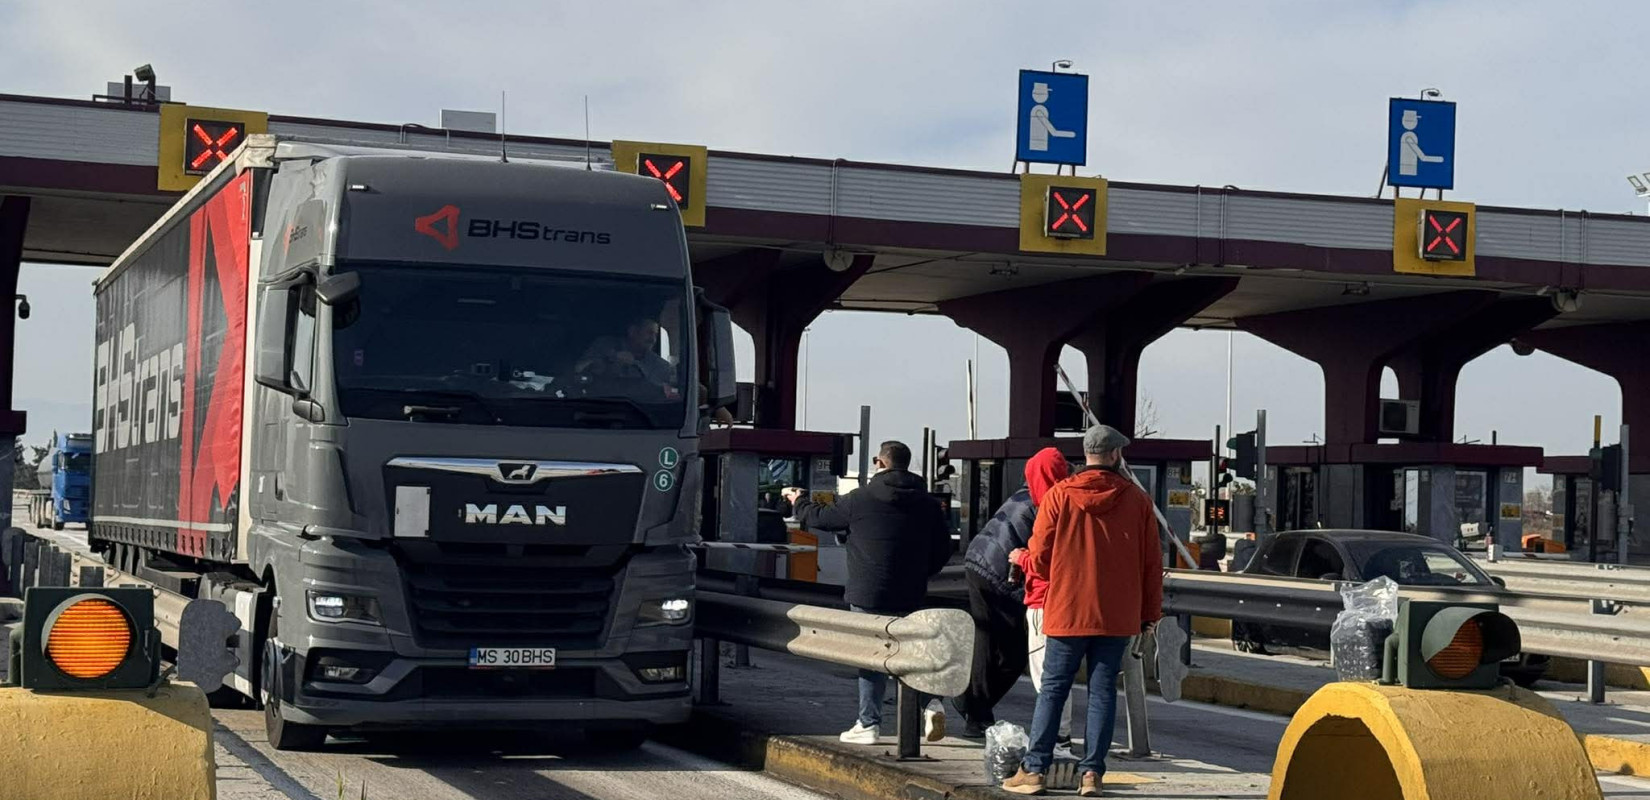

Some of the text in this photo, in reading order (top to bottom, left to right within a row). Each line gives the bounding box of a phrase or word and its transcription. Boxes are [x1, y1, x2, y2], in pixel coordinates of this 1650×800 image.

[664, 451, 674, 465] L
[659, 473, 668, 487] 6
[465, 503, 566, 525] MAN
[477, 649, 498, 664] MS
